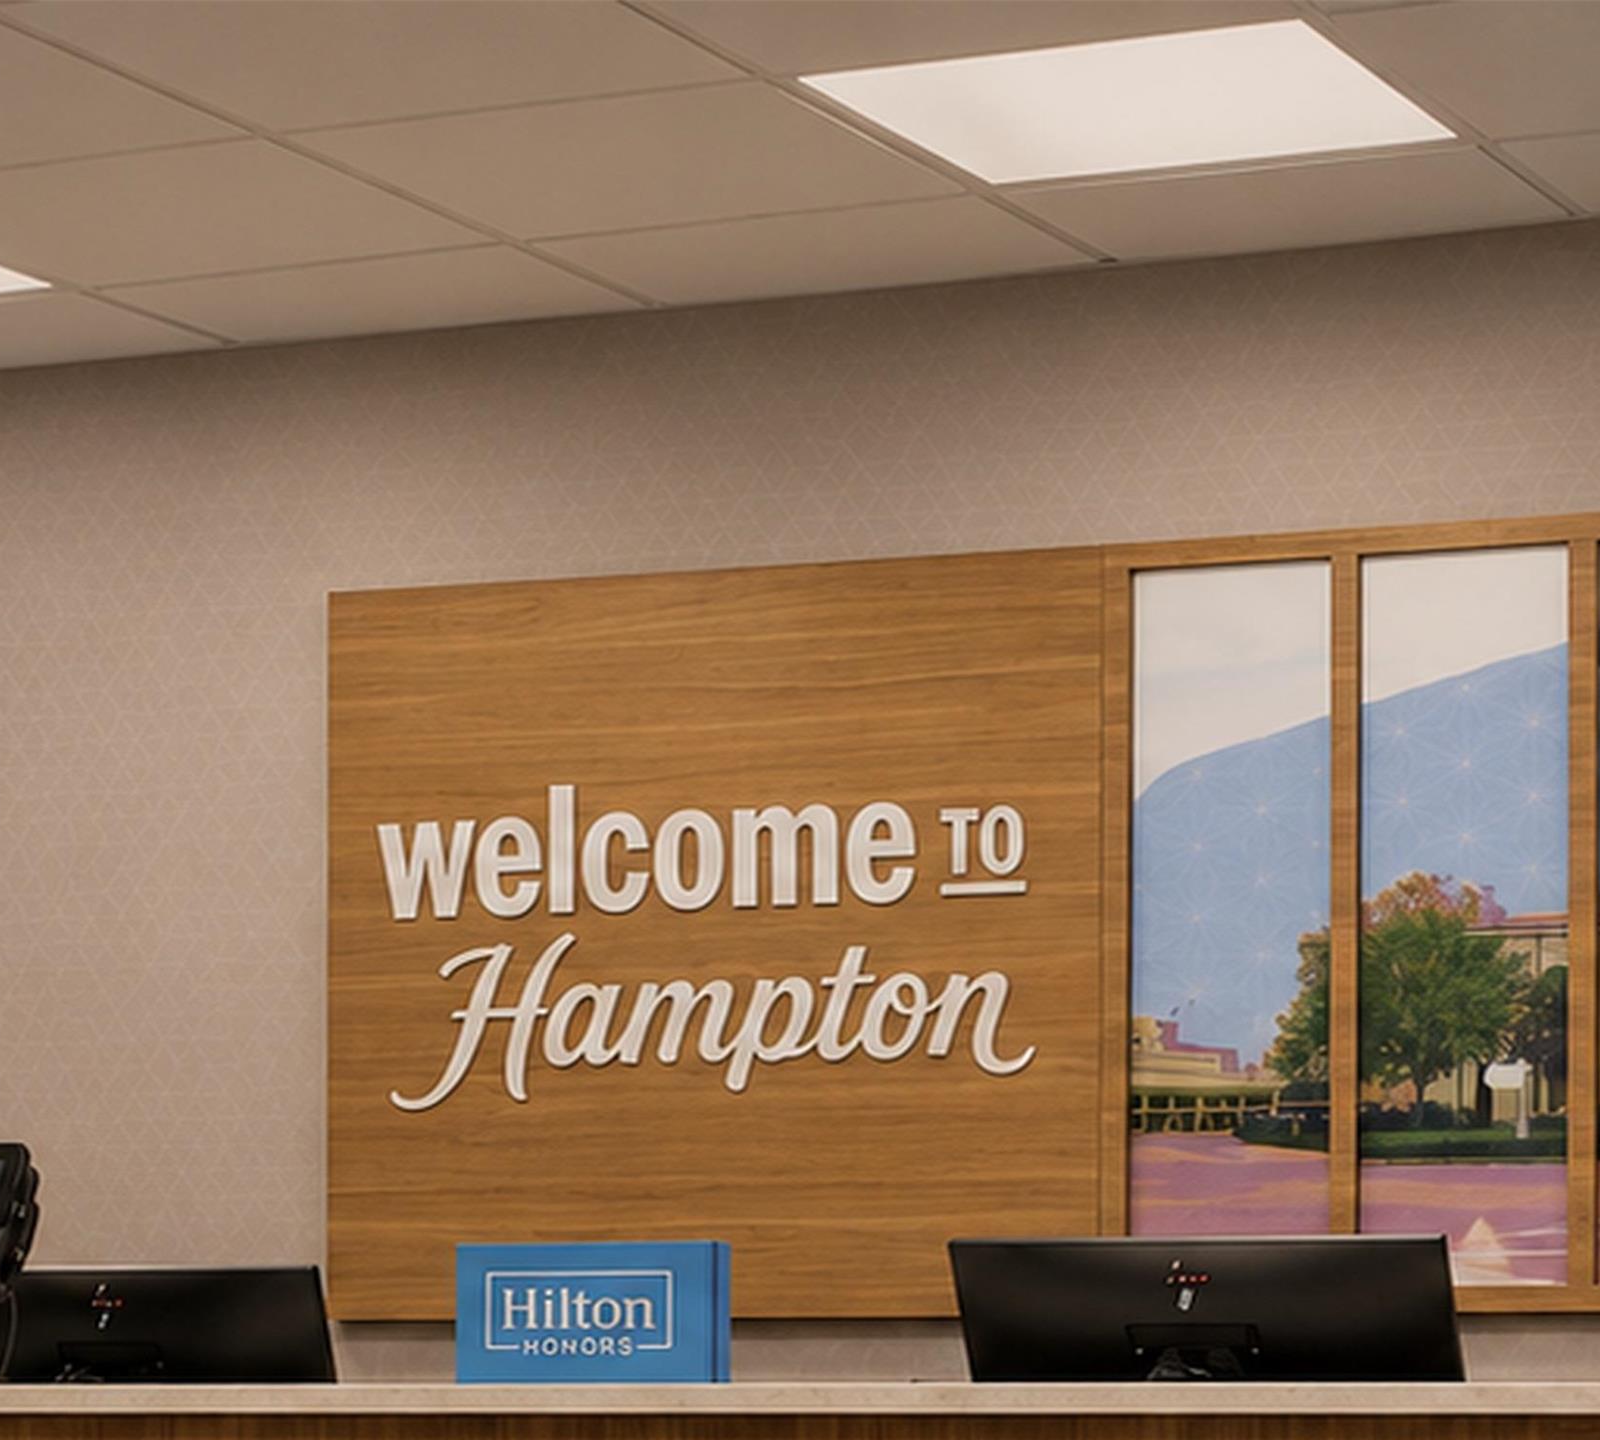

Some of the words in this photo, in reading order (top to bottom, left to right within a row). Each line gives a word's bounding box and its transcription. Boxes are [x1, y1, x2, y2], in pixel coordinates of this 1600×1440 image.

[376, 783, 917, 921] welcome
[939, 804, 1026, 877] TO
[389, 932, 1037, 1111] Hampton
[502, 1287, 656, 1330] Hilton
[522, 1336, 633, 1356] HONORS
